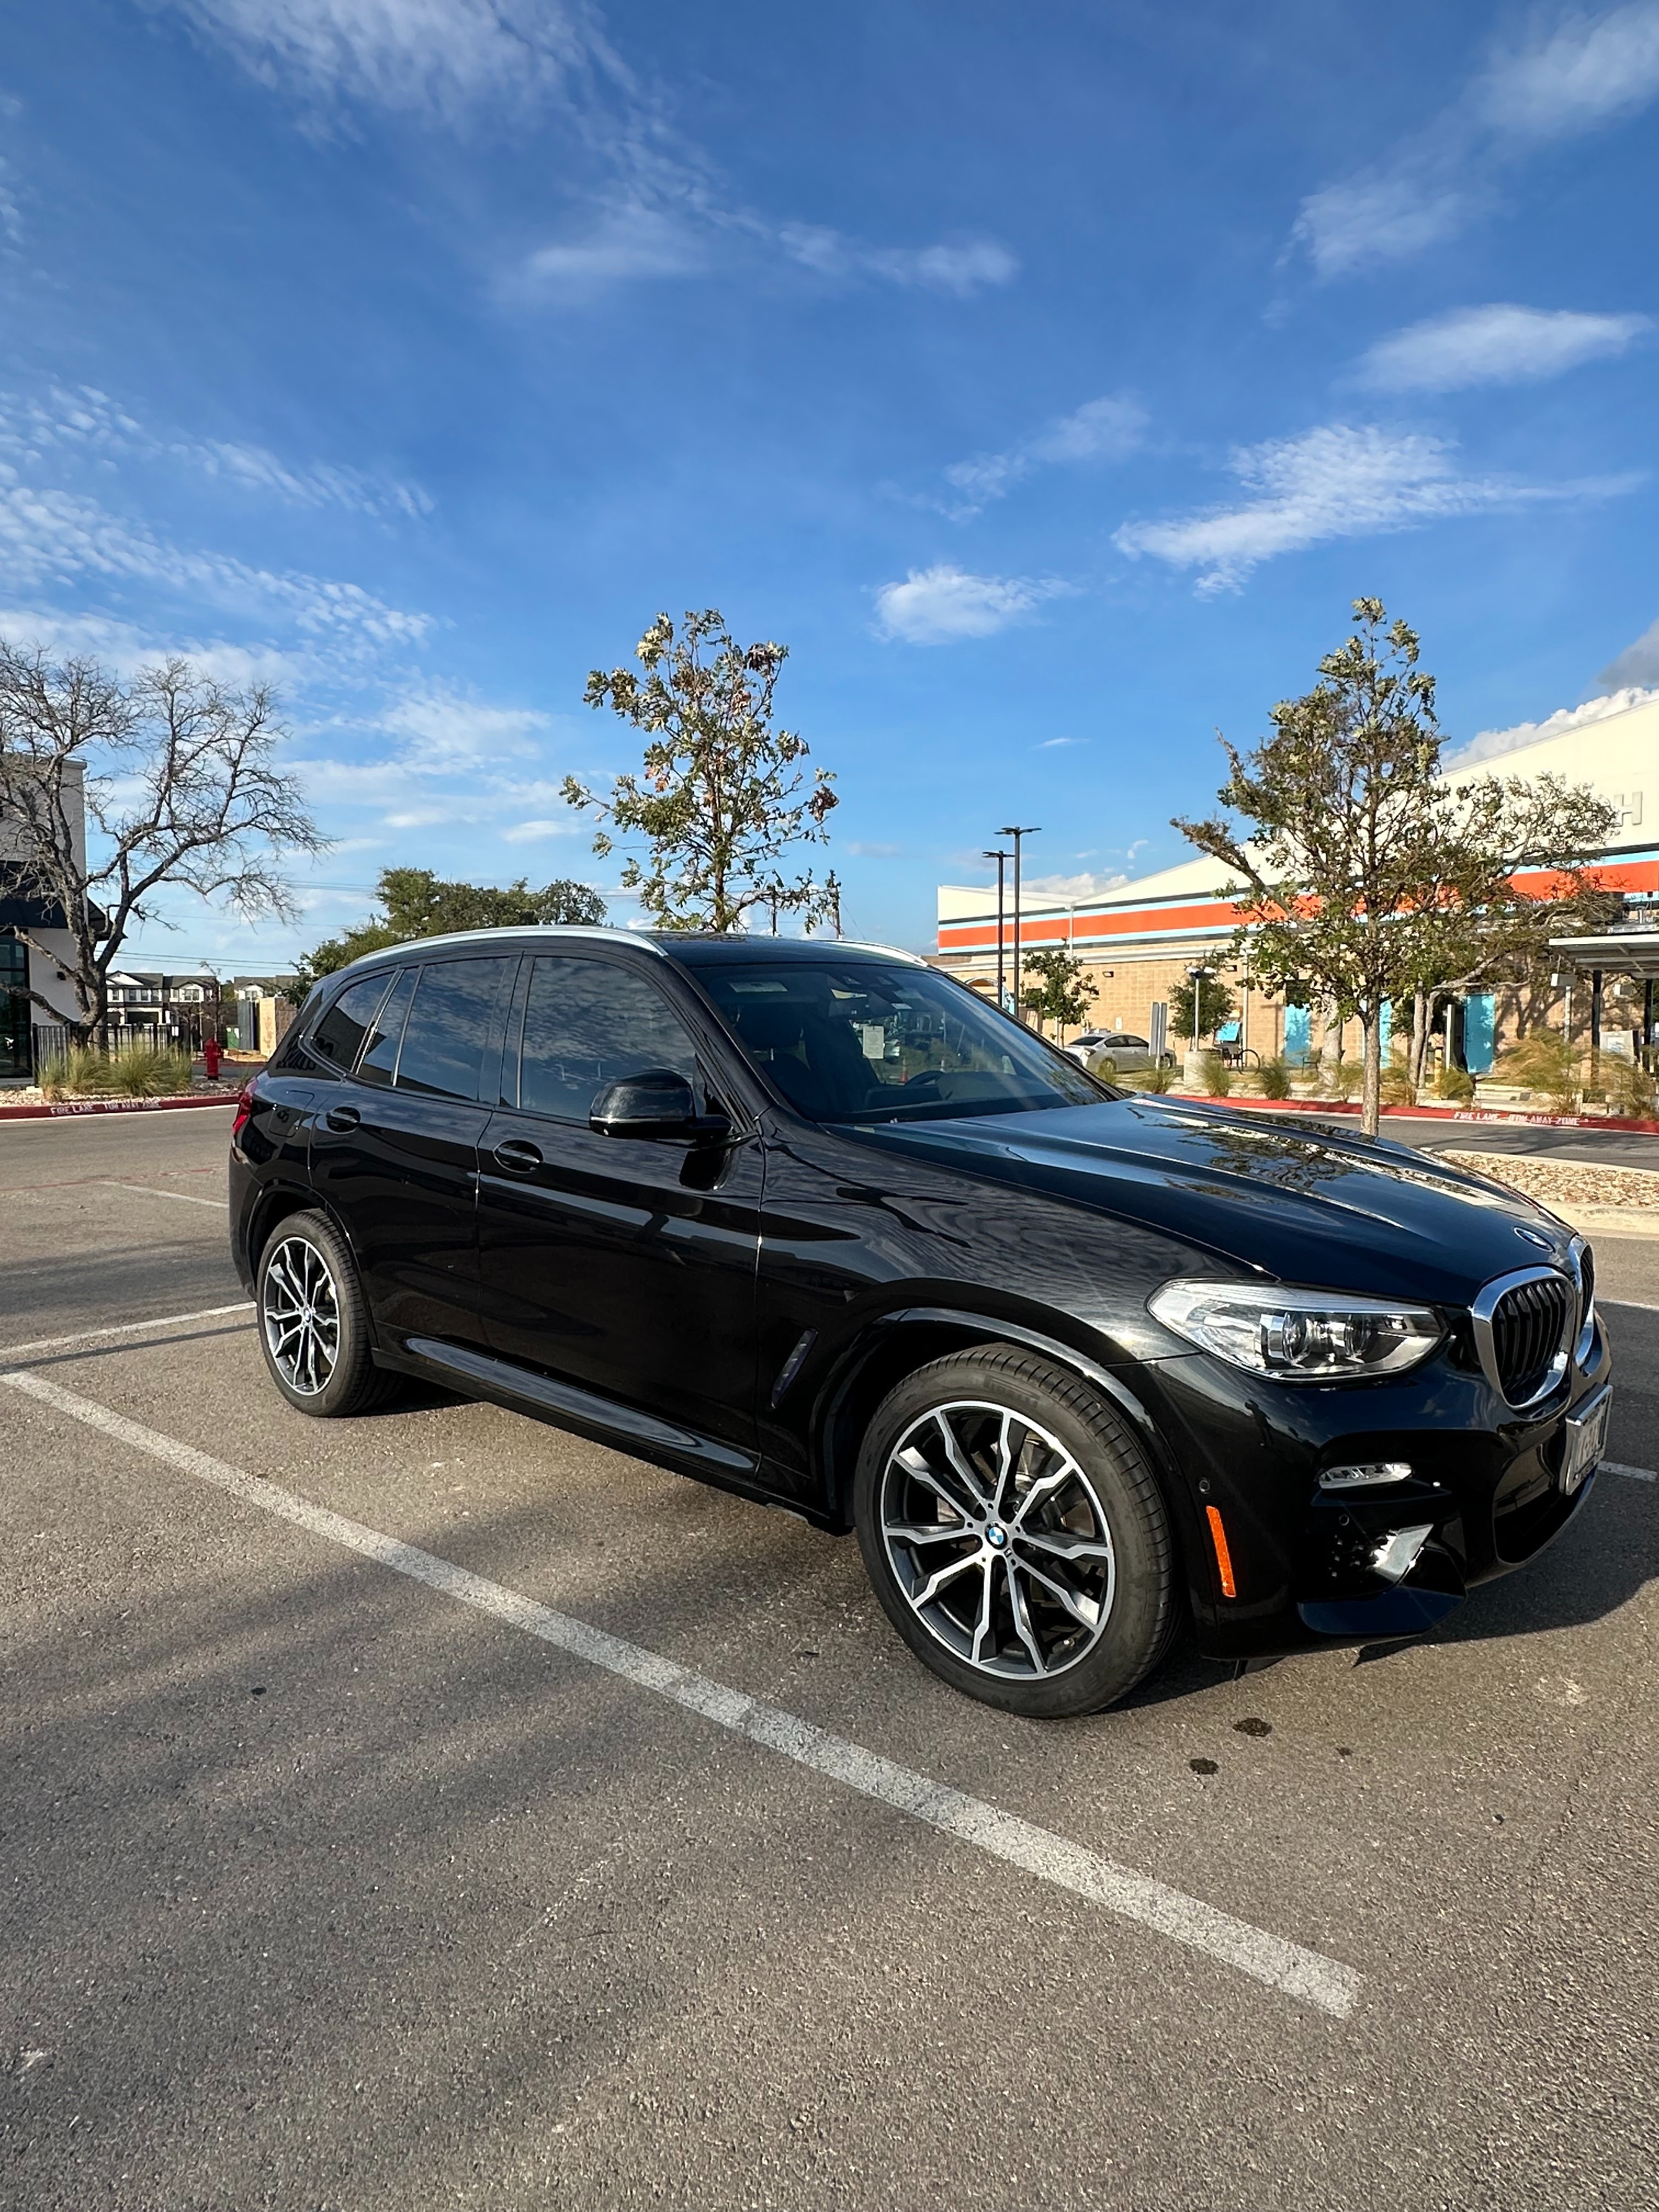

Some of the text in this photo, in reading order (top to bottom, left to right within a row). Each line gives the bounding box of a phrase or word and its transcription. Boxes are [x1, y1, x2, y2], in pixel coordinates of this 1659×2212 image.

[1454, 1111, 1475, 1120] FIRE
[1476, 1113, 1499, 1121] LANE
[1555, 1117, 1580, 1125] ZONE
